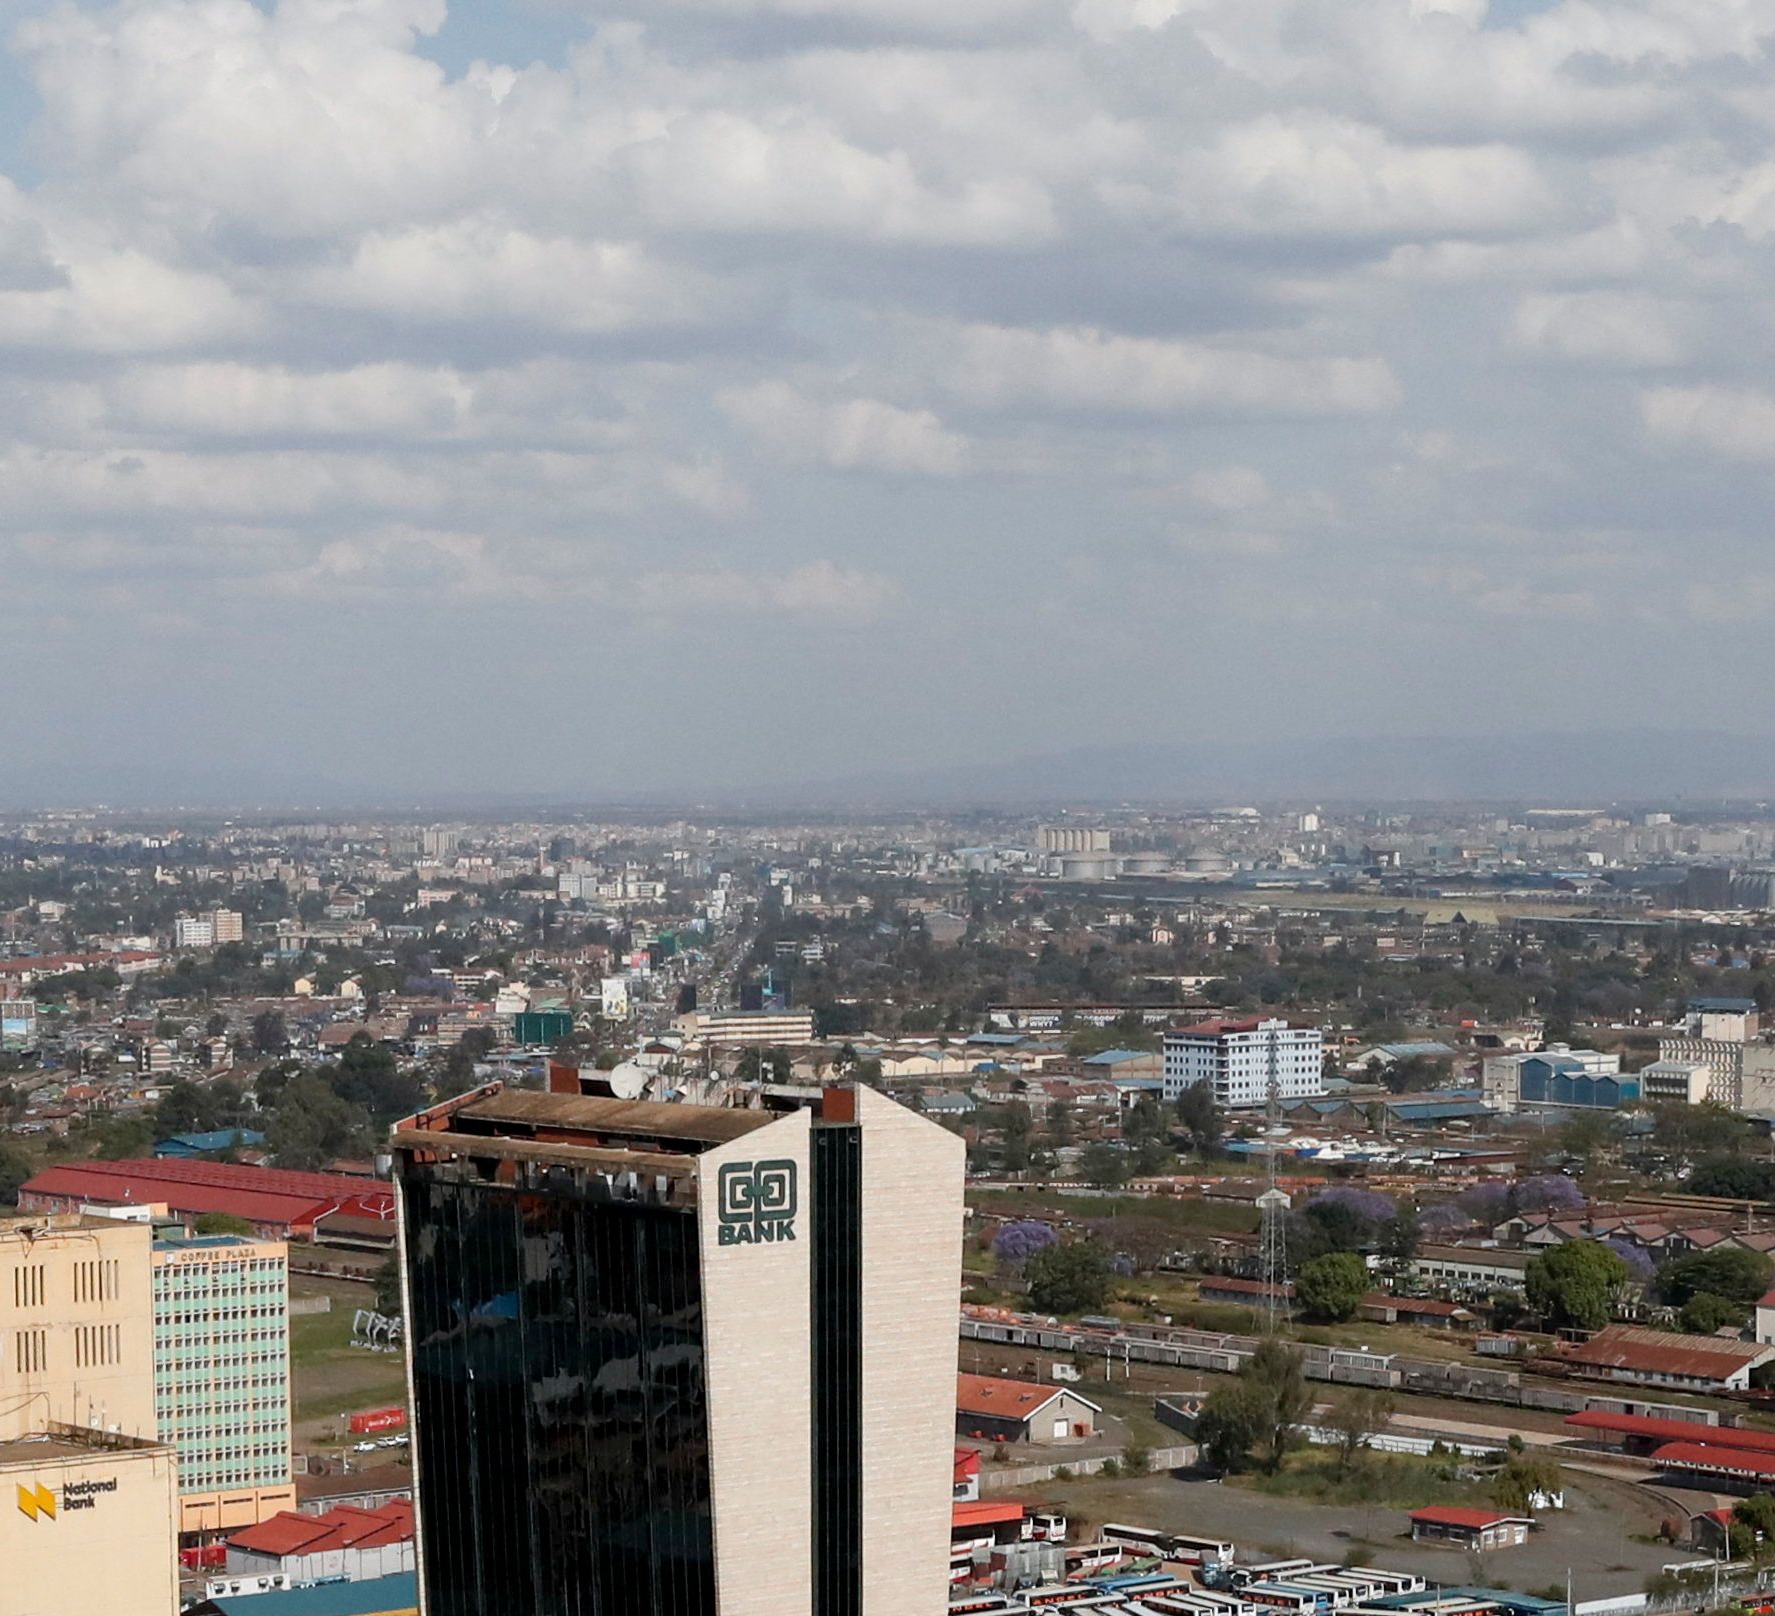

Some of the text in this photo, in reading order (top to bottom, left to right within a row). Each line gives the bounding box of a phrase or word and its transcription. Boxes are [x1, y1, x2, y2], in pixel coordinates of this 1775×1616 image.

[718, 1219, 796, 1246] BANK
[181, 1248, 256, 1262] COFFEE PLAZA
[63, 1476, 117, 1496] National
[63, 1494, 95, 1511] Bank
